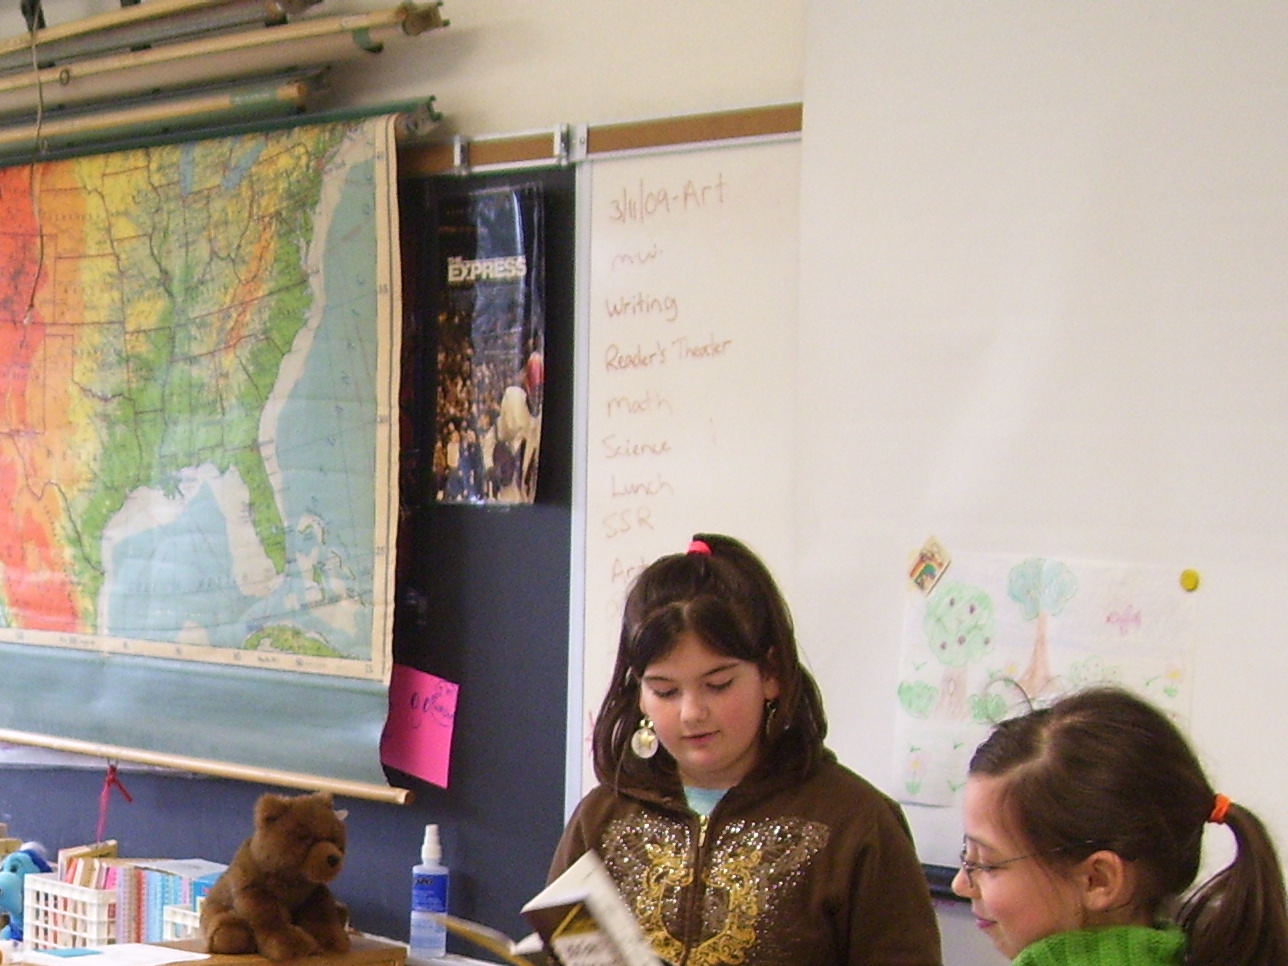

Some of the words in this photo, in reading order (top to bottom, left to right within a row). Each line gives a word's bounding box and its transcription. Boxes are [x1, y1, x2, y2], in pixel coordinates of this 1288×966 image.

[447, 256, 527, 283] EXPRESS
[602, 434, 671, 459] Science
[612, 475, 674, 497] Lunch
[602, 506, 654, 538] SSR
